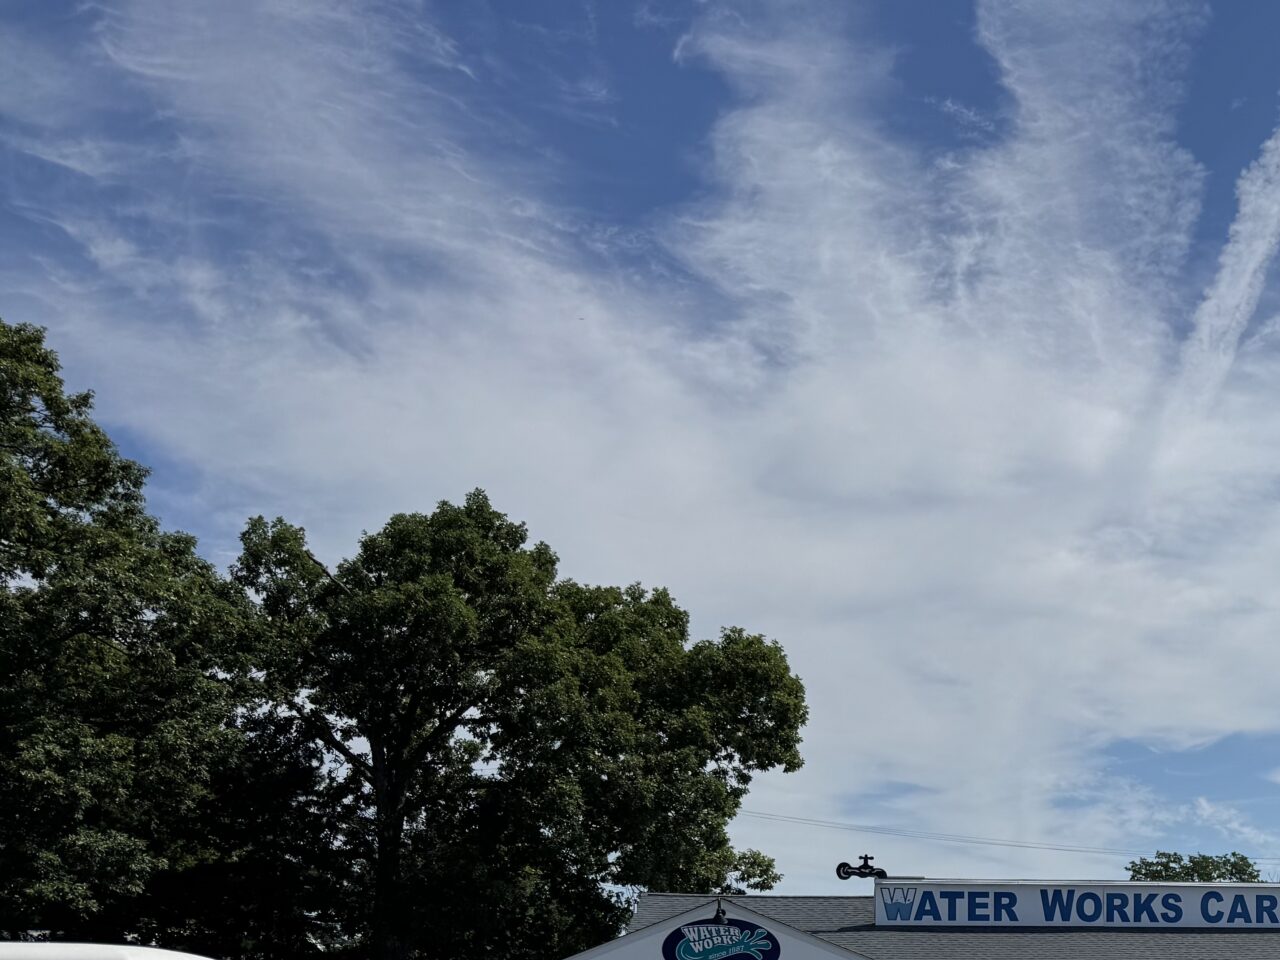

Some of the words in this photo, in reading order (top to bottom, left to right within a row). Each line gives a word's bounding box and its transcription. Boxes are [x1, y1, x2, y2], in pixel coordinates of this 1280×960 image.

[880, 887, 1019, 922] WATER
[1040, 888, 1184, 924] WORKS
[1200, 890, 1280, 924] CAR
[682, 926, 740, 942] WATER
[689, 935, 740, 953] WORKS
